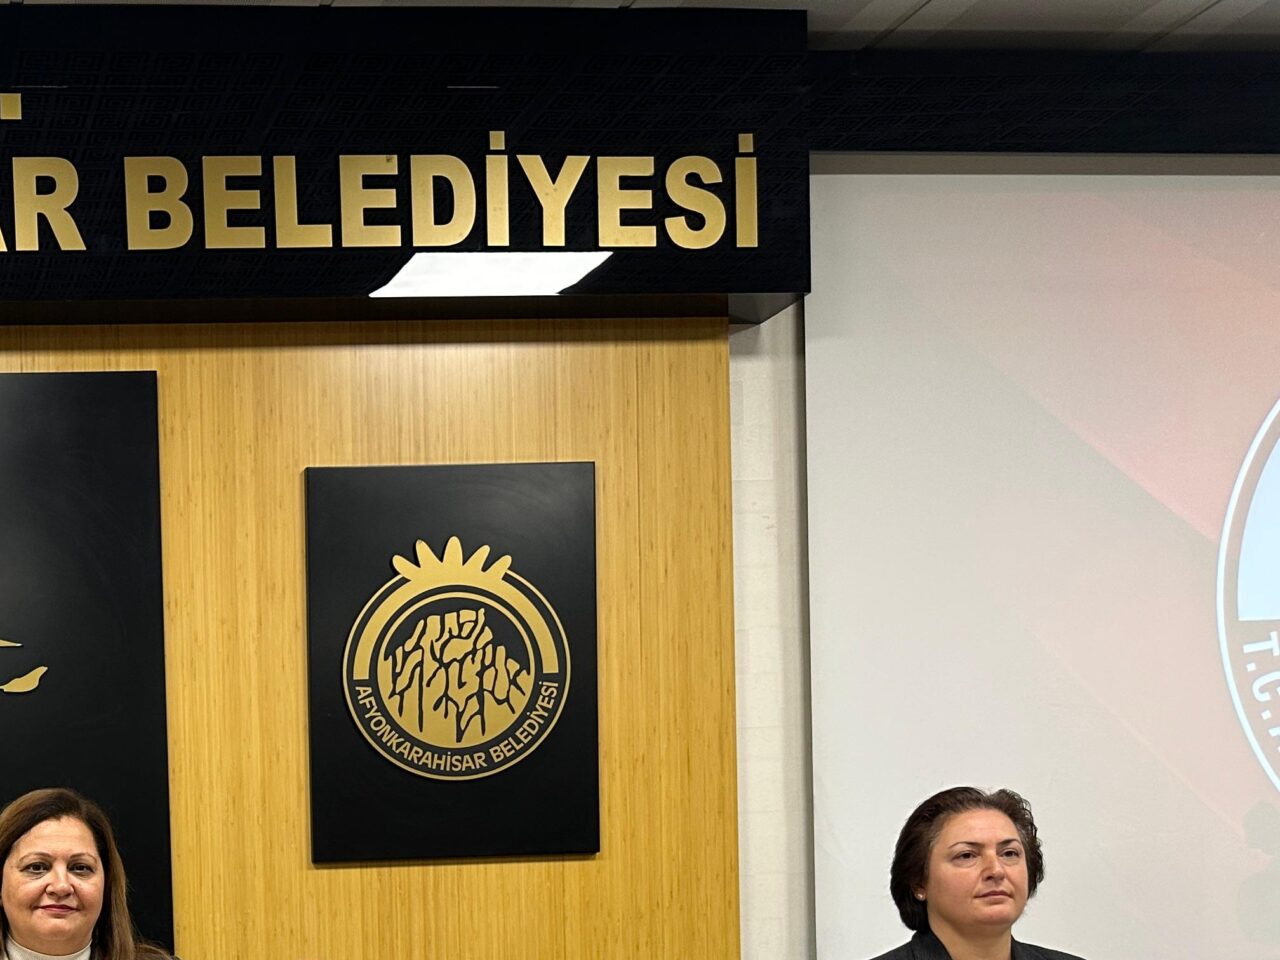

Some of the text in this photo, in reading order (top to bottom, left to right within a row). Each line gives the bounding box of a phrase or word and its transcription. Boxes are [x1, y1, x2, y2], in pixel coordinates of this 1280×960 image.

[124, 131, 758, 250] BELEDİYESİ
[355, 681, 559, 771] AFYONKARAHİSAR BELEDİYESİ
